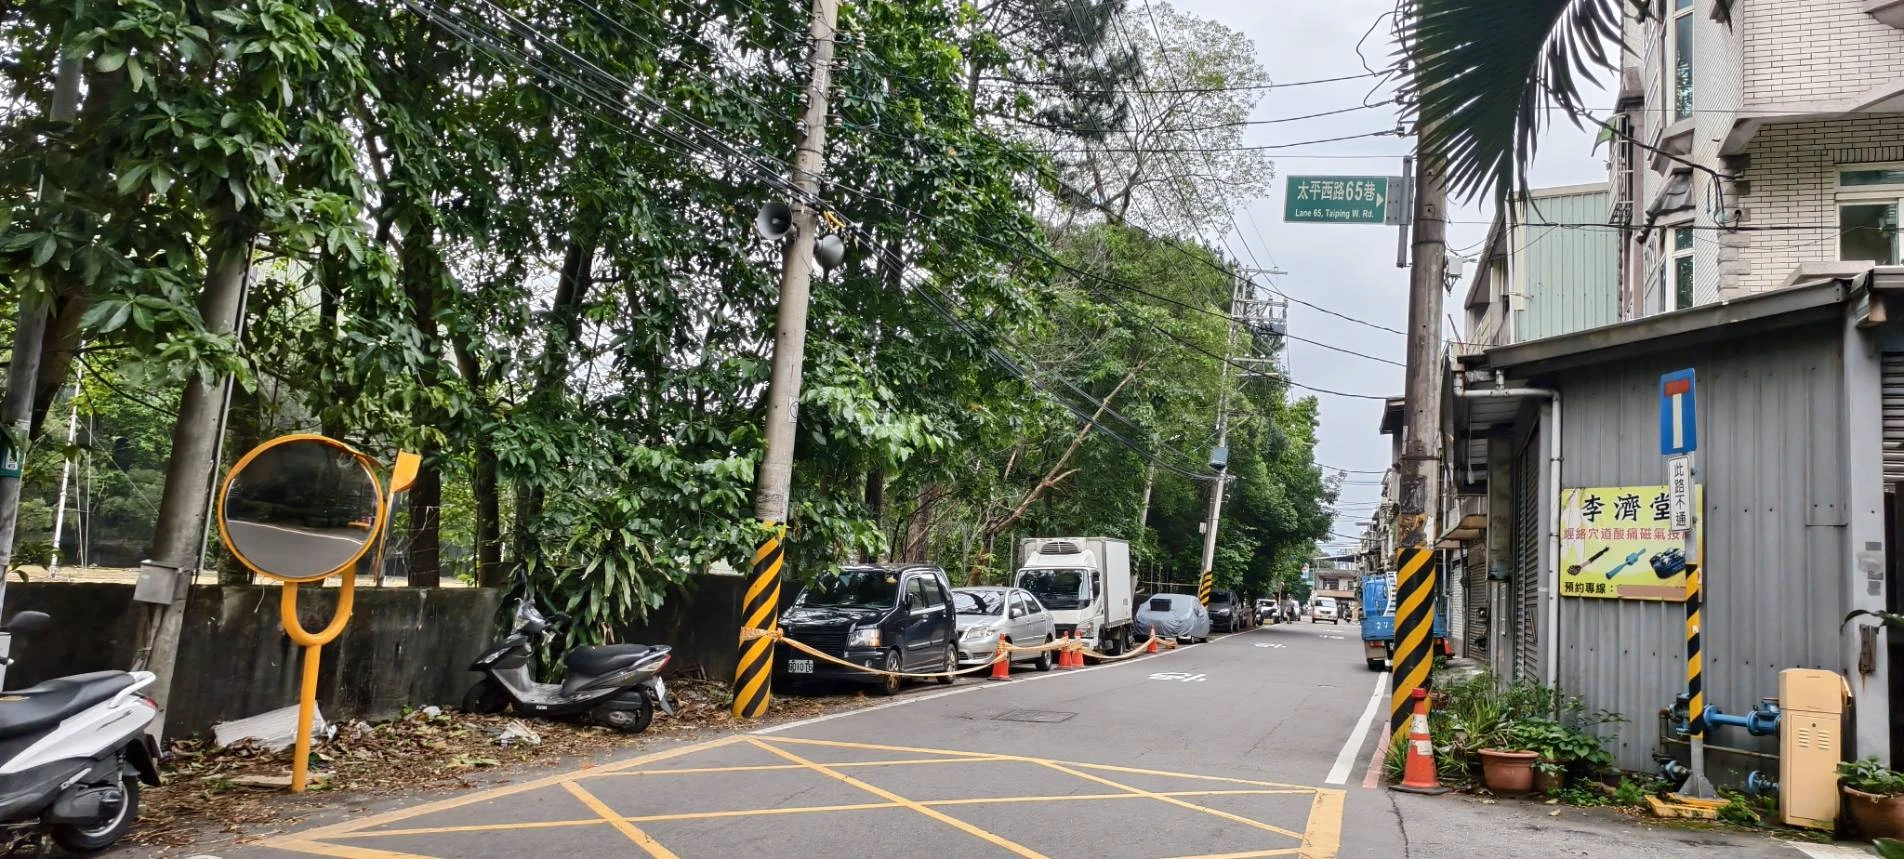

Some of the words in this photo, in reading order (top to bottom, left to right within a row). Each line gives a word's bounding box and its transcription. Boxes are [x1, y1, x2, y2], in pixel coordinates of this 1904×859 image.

[1297, 180, 1376, 201] 太平西路65巷
[1295, 208, 1312, 217] Lane
[1313, 209, 1324, 218] 65,
[1325, 209, 1350, 219] Taiping
[1352, 210, 1360, 218] W.
[1362, 209, 1374, 218] Rd.
[1674, 461, 1687, 527] 此路不通
[1581, 493, 1670, 523] 李濟堂
[1563, 527, 1685, 541] 經絡穴道酸痛磁氣按
